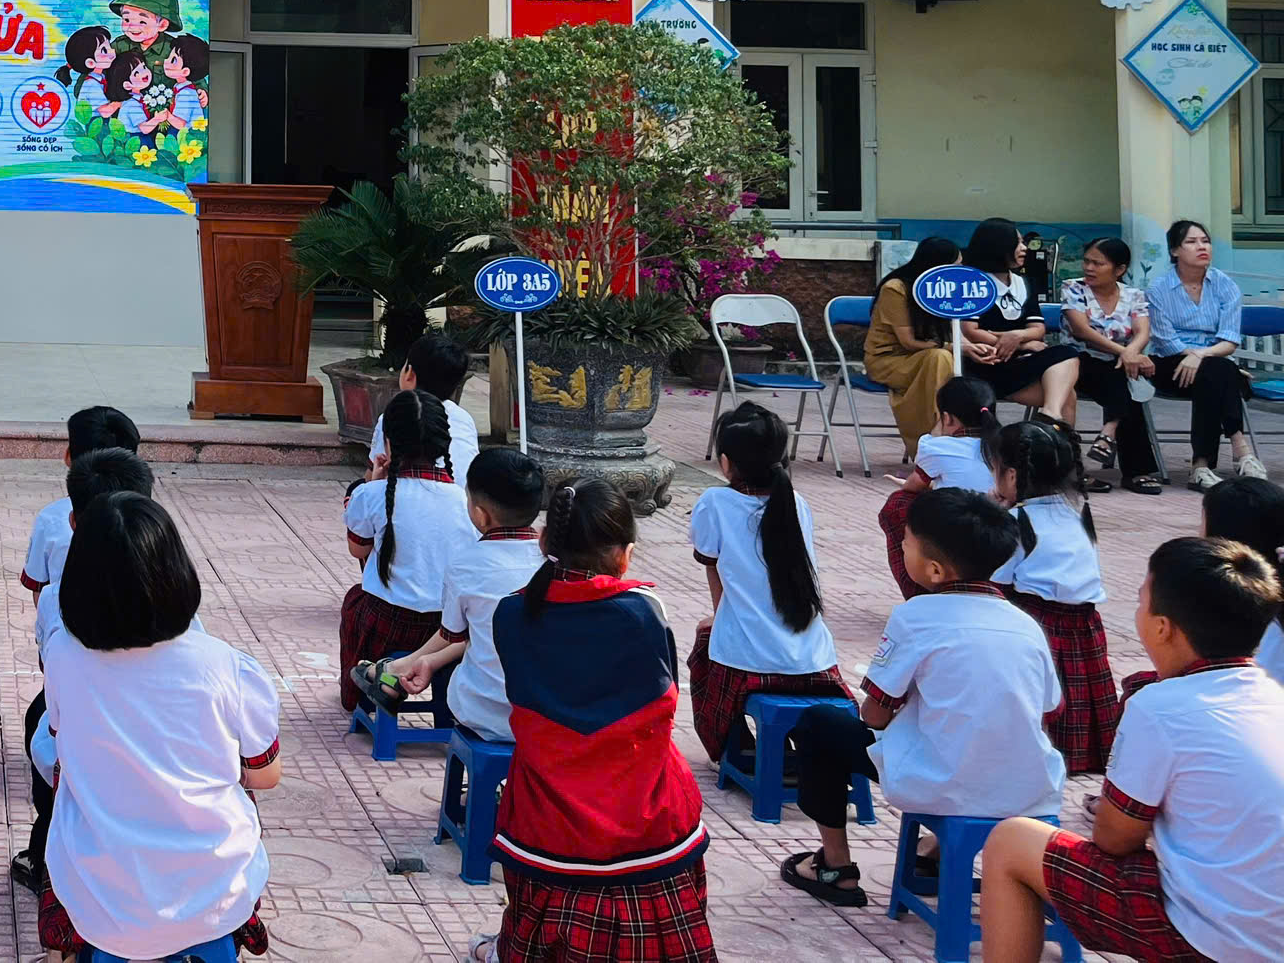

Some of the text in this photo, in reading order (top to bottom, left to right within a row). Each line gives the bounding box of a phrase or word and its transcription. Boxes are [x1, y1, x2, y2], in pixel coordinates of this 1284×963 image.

[661, 18, 697, 29] TRƯỜNG
[1151, 42, 1168, 54] HỌC
[1170, 43, 1191, 52] SINH
[22, 135, 41, 143] SỐNG
[17, 143, 37, 152] SỐNG
[38, 143, 48, 152] CÓ
[486, 268, 518, 291] LỚP
[522, 273, 551, 291] 3A5
[925, 276, 988, 299] LỚP 1A5
